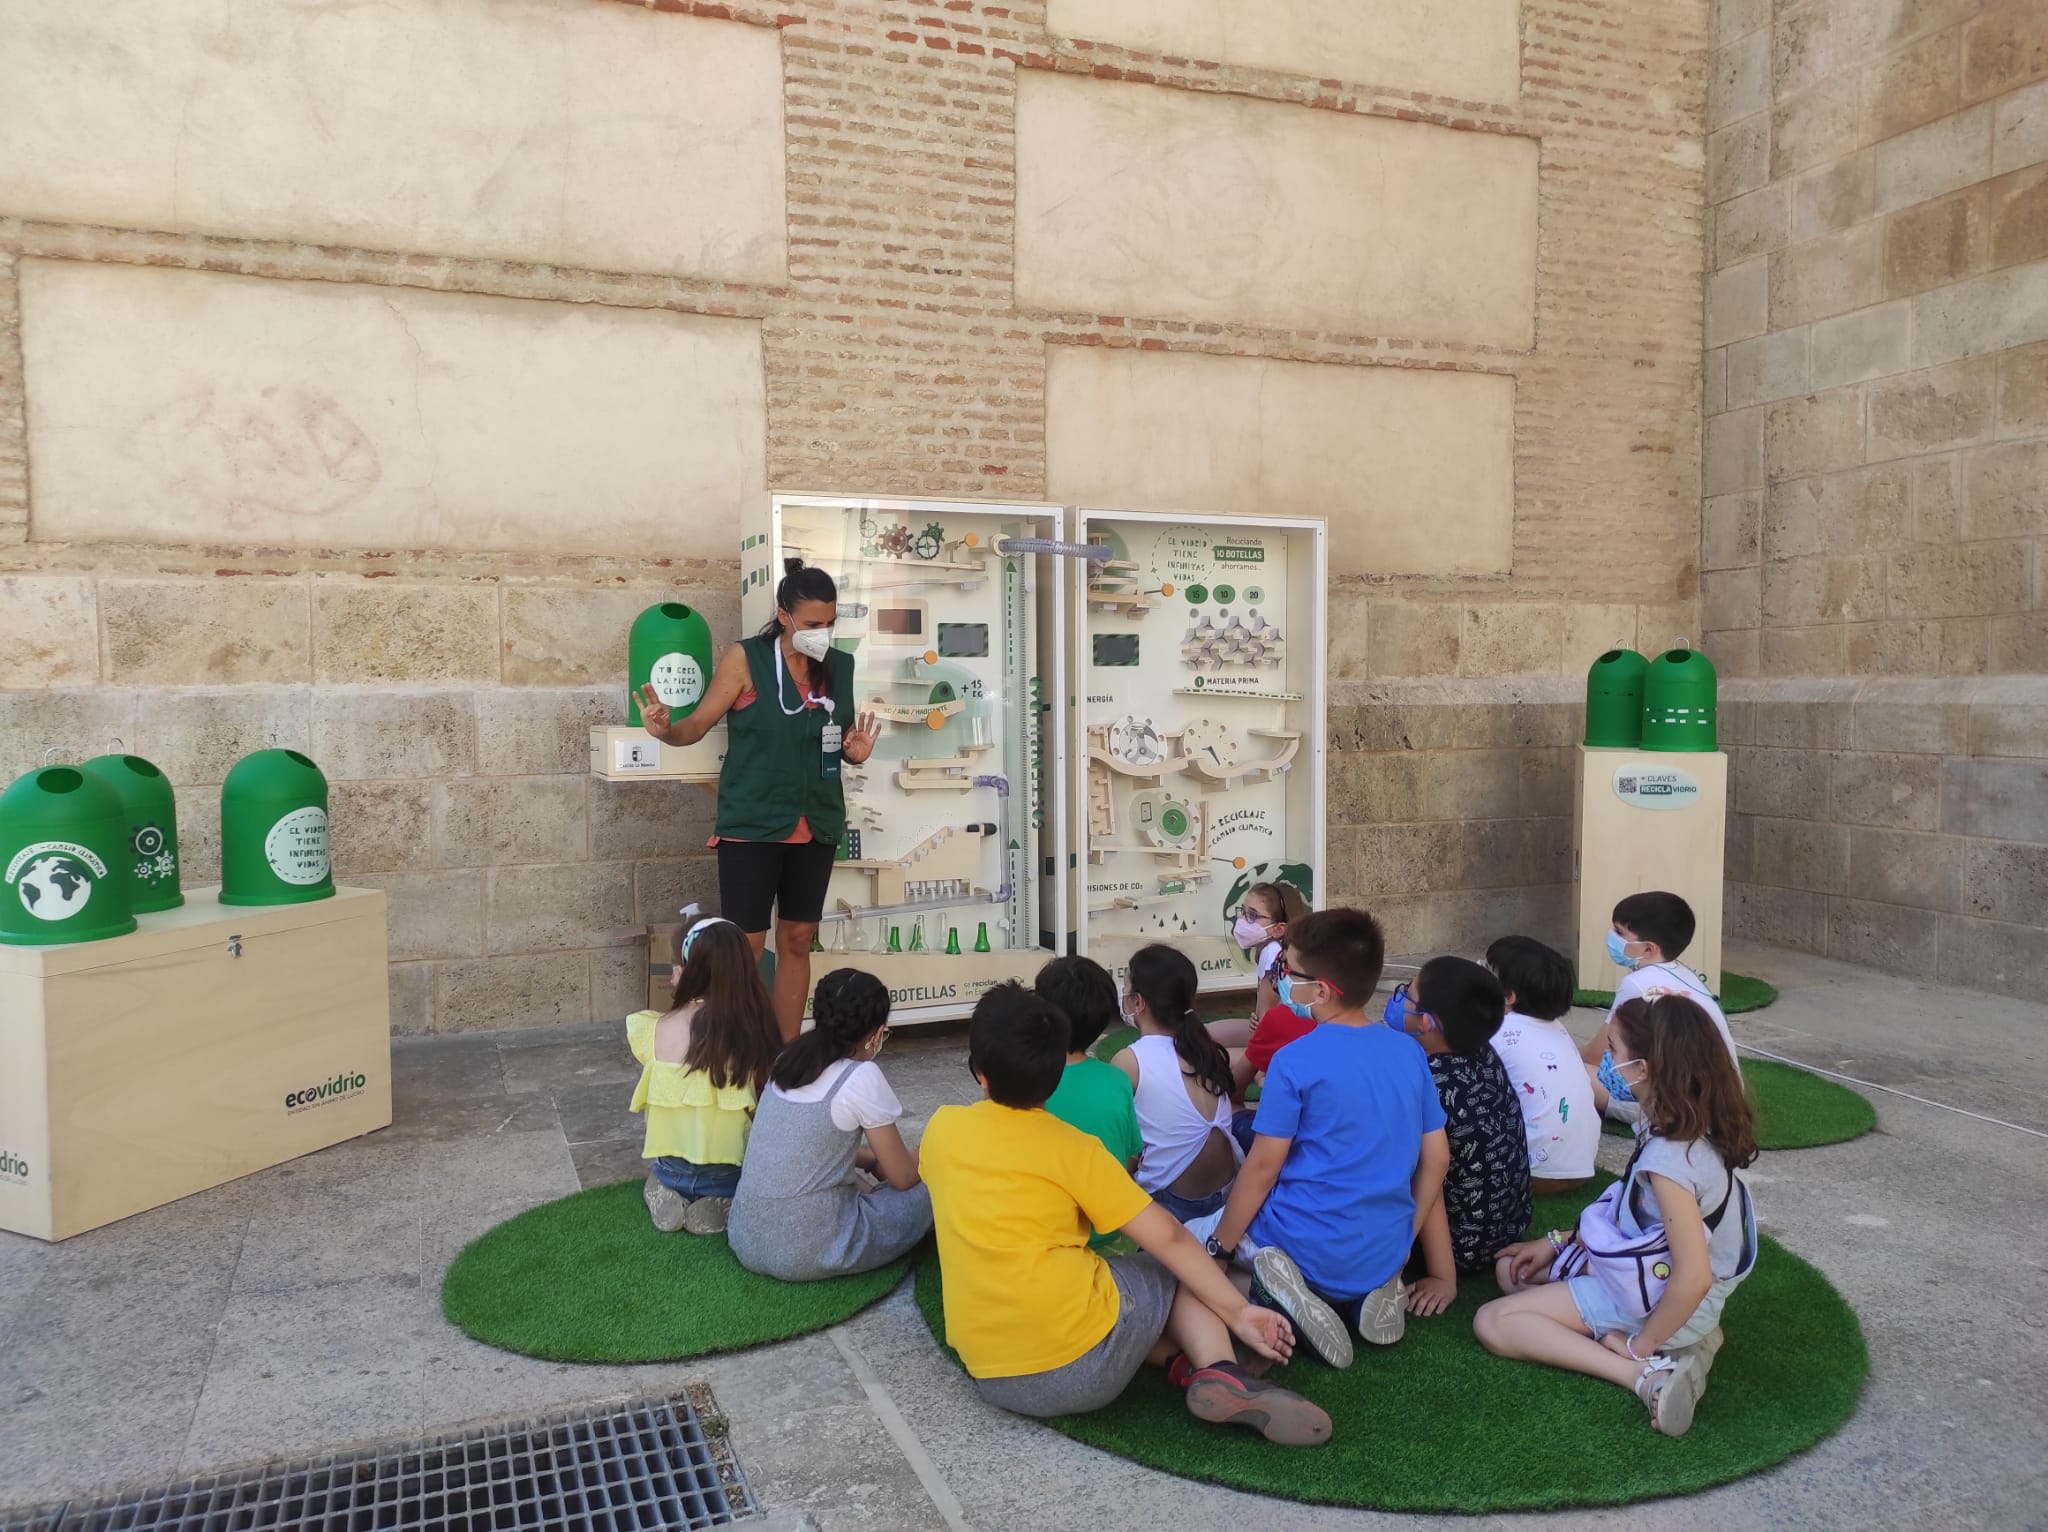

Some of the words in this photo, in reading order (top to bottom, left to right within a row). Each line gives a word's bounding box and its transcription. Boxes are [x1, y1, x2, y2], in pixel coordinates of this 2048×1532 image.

[1226, 536, 1263, 546] Reciclando
[1216, 549, 1225, 558] 10
[1226, 550, 1263, 559] BOTELLAS
[1167, 561, 1205, 572] INFINITAS
[1173, 573, 1195, 582] VIDAS
[1192, 591, 1200, 599] 15
[1220, 591, 1229, 599] 10
[1249, 591, 1259, 599] 20
[971, 680, 982, 689] 15
[1207, 677, 1236, 685] MATERIA
[663, 688, 692, 696] CLAVE
[1087, 692, 1114, 704] NERGÍA
[1641, 785, 1672, 793] RECICLA
[1218, 810, 1266, 826] RECICLAJE
[1212, 827, 1236, 845] CAMBIO
[296, 837, 321, 845] TIENE
[297, 860, 320, 868] VIDAS
[1120, 882, 1129, 891] DE
[1201, 959, 1232, 971] CLAVE
[972, 978, 998, 988] reciclan
[889, 984, 957, 1004] BOTELLAS
[285, 1070, 366, 1108] ecovidrio
